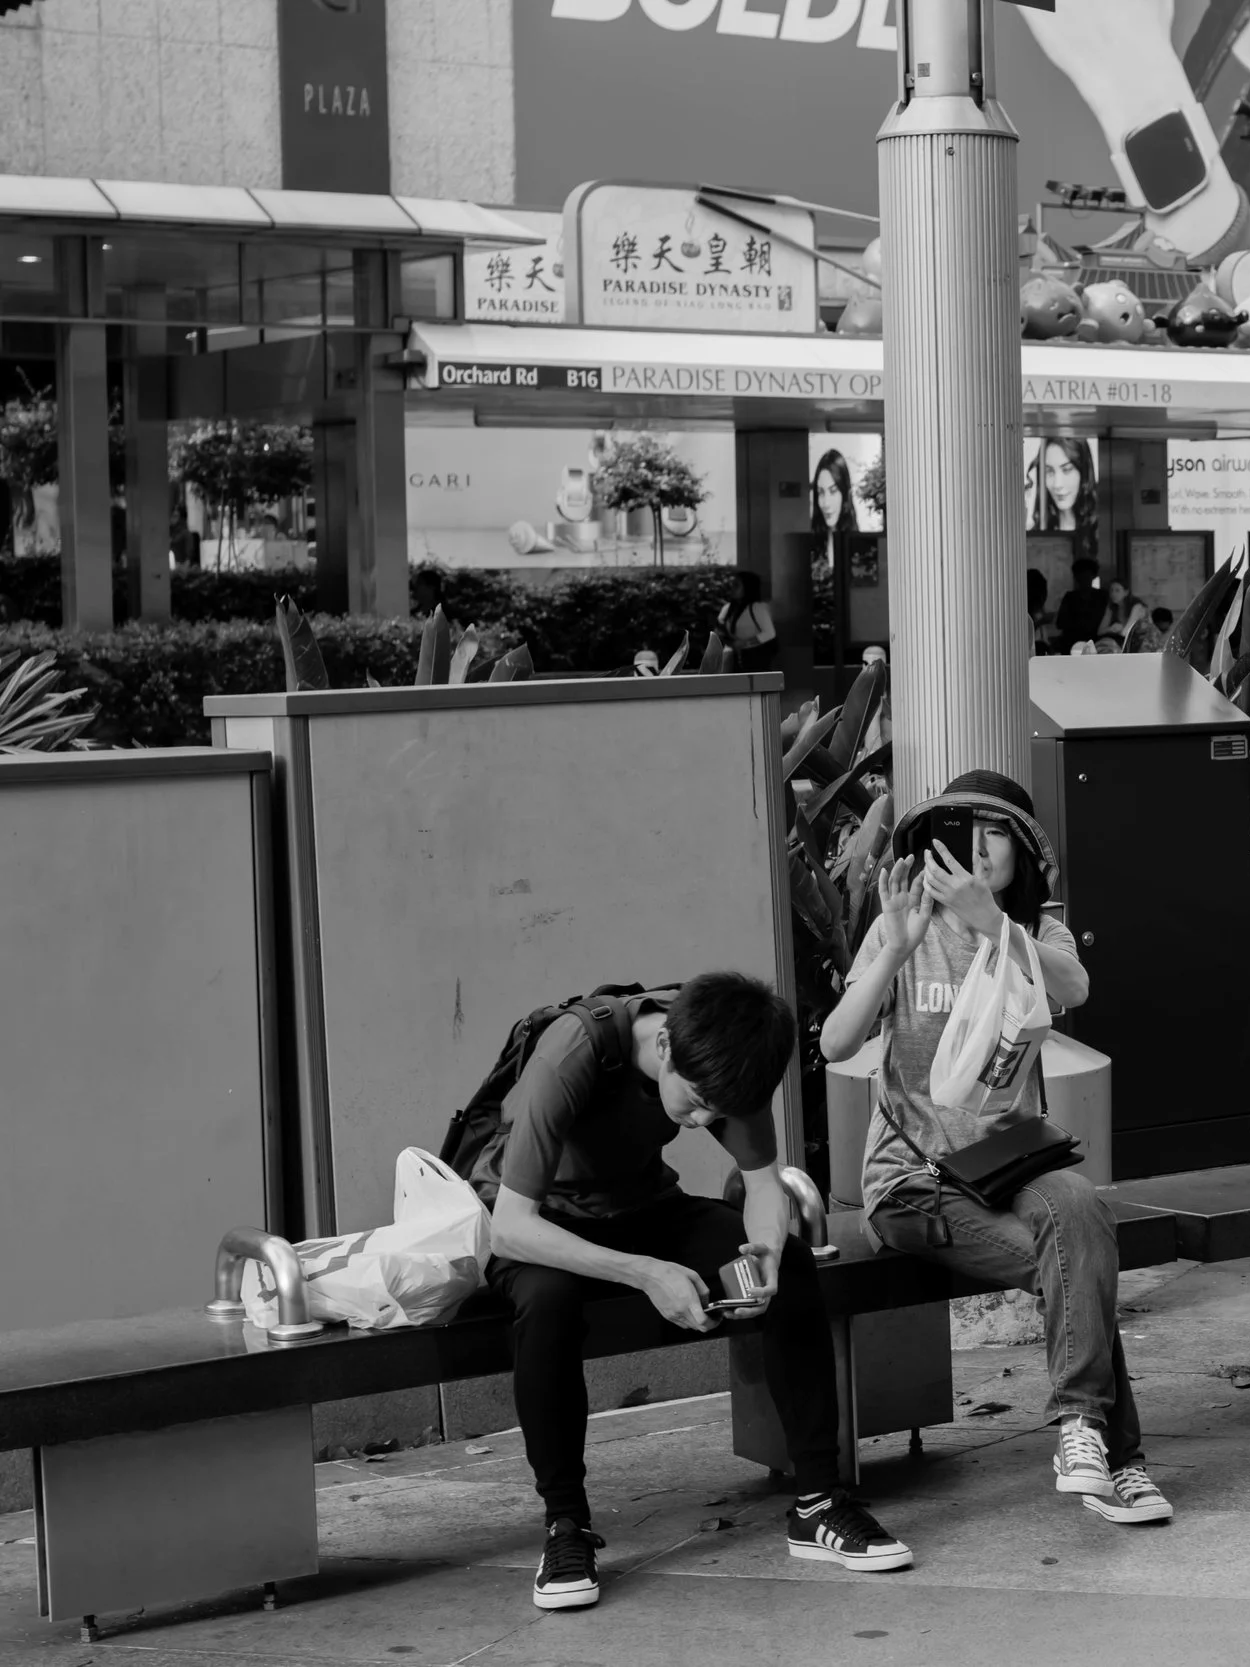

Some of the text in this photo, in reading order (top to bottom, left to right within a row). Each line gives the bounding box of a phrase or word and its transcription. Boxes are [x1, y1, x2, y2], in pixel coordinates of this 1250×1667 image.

[303, 83, 371, 117] PLAZA
[602, 278, 688, 295] PARADISE
[695, 282, 773, 299] DYNASTY
[476, 297, 560, 314] PARADISE
[442, 366, 539, 386] Orchard Rd
[566, 369, 599, 388] B16
[612, 366, 726, 392] PARADISE
[734, 368, 842, 395] DYNASTY
[1042, 379, 1102, 402] ATRIA
[1107, 381, 1173, 403] #01-18
[408, 472, 471, 488] GARI
